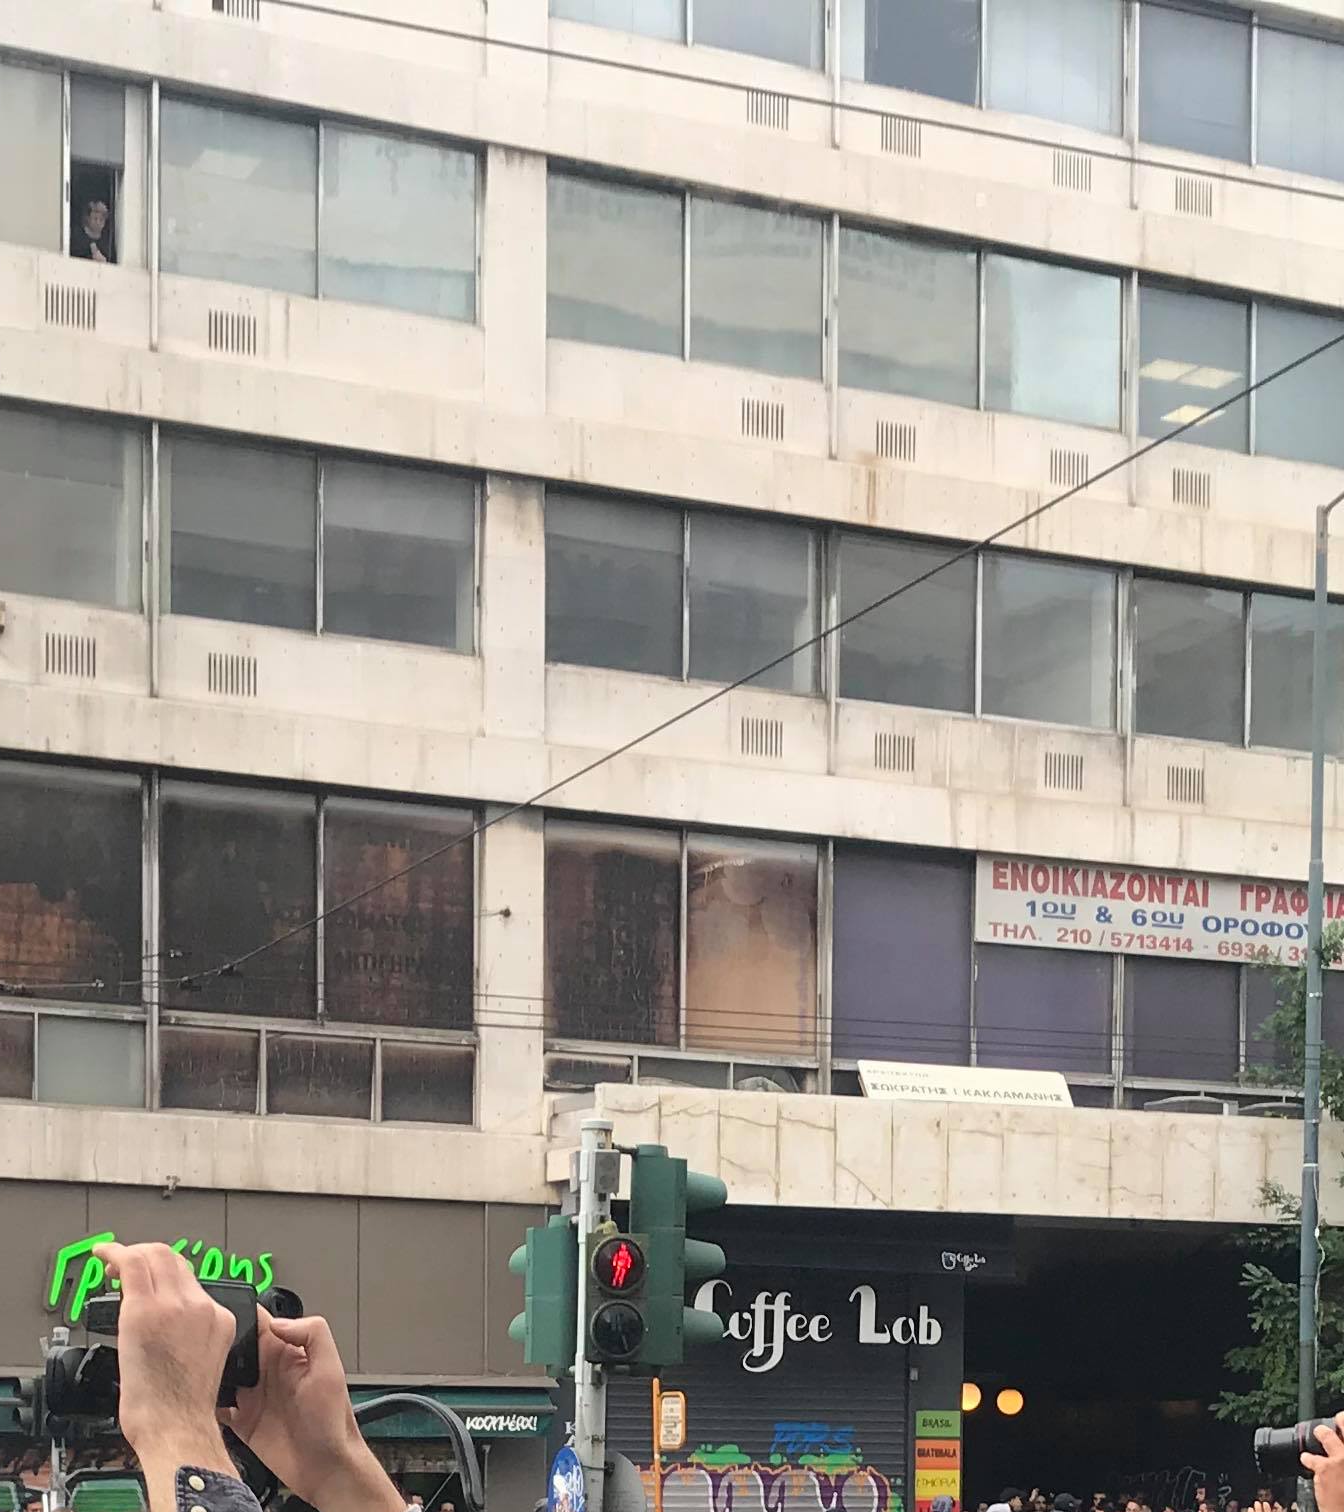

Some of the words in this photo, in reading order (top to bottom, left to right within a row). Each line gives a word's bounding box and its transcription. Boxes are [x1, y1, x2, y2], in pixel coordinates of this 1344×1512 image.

[992, 860, 1210, 908] ΕΝΟΙΚΙΑΖΟΝΤΑΙ
[1095, 905, 1113, 925] &
[1056, 926, 1092, 945] 210
[869, 1081, 949, 1096] ΣΩΚΡΑΤΗΣ
[962, 1086, 1064, 1102] ΚΑΚΛΑΜΑΝΗΣ
[694, 1278, 834, 1374] Coffee
[848, 1284, 943, 1346] Lab
